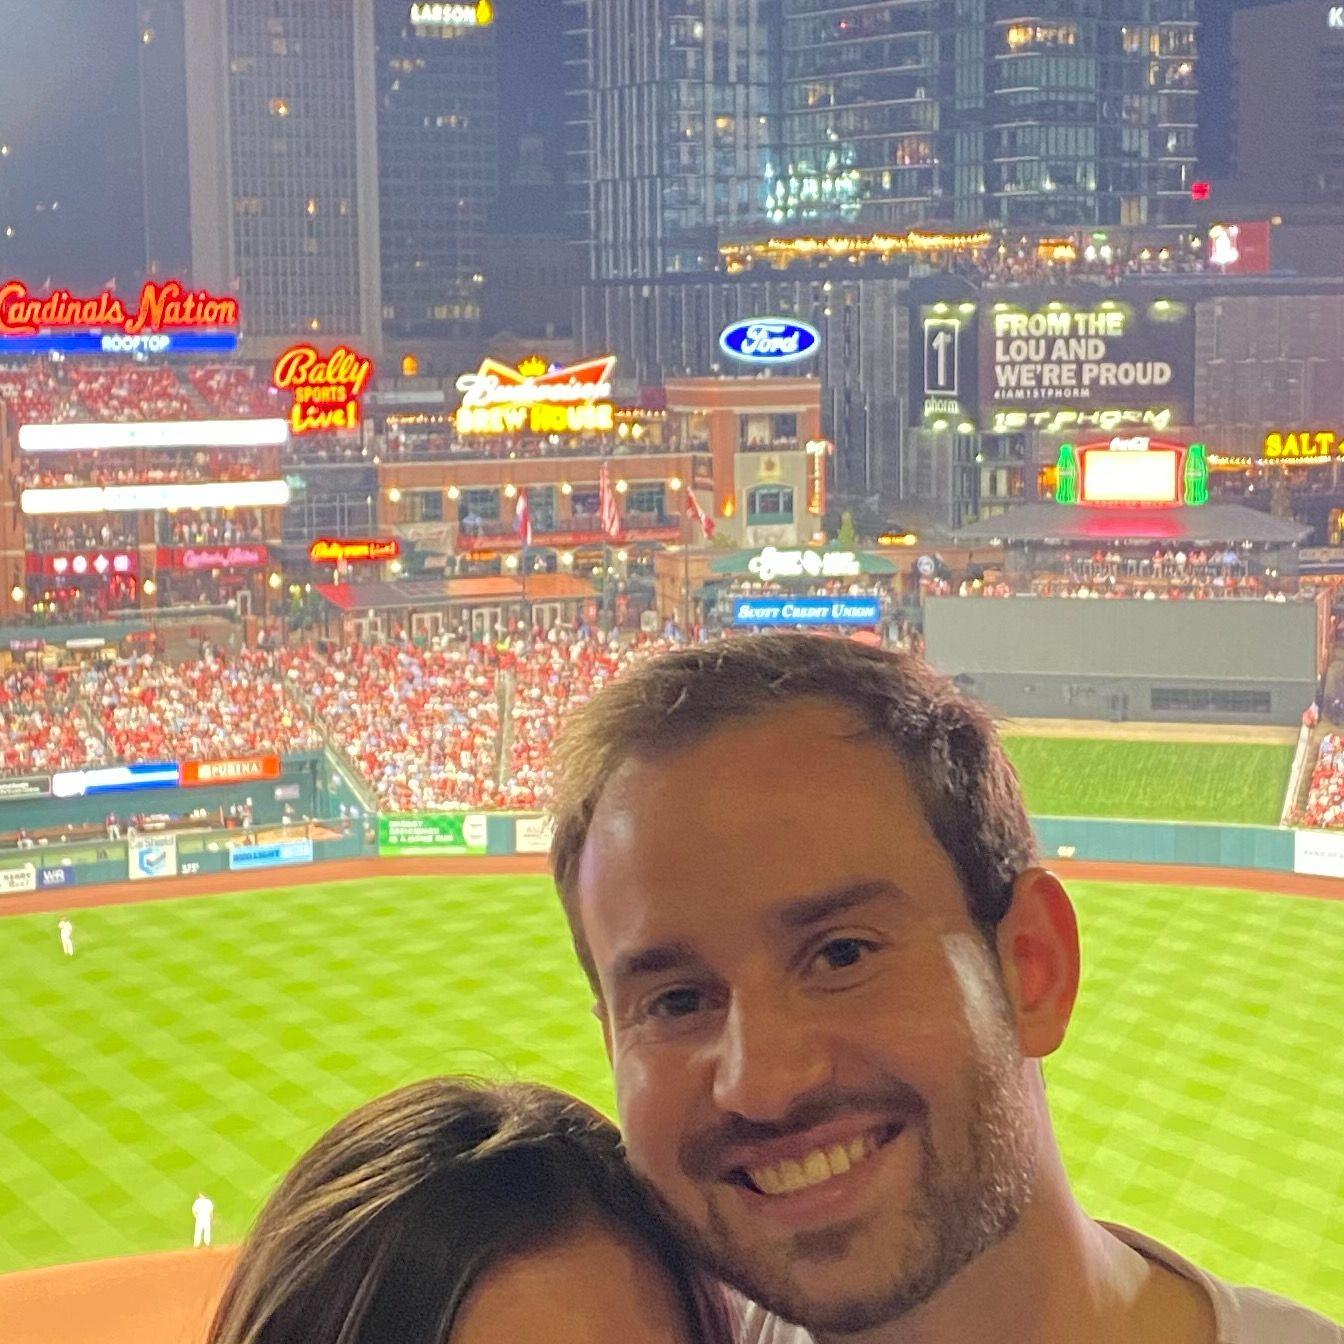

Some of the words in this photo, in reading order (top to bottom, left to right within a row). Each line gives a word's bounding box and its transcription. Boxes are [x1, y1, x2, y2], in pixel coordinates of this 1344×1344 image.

[410, 3, 476, 25] LARSON
[123, 281, 238, 334] Nation
[994, 312, 1071, 337] FROM
[1073, 311, 1124, 337] THE
[102, 335, 170, 352] ROOFTOP
[741, 324, 800, 354] Ford
[994, 339, 1047, 362] LOU
[1049, 338, 1106, 362] AND
[275, 345, 370, 395] Bally
[993, 363, 1077, 388] WE'RE
[1081, 361, 1172, 386] PROUD
[294, 385, 346, 403] SPORTS
[291, 401, 356, 432] Live!
[456, 407, 528, 433] BREW
[529, 404, 613, 432] HOUSE
[923, 398, 959, 417] phorm
[1265, 431, 1335, 457] SALT
